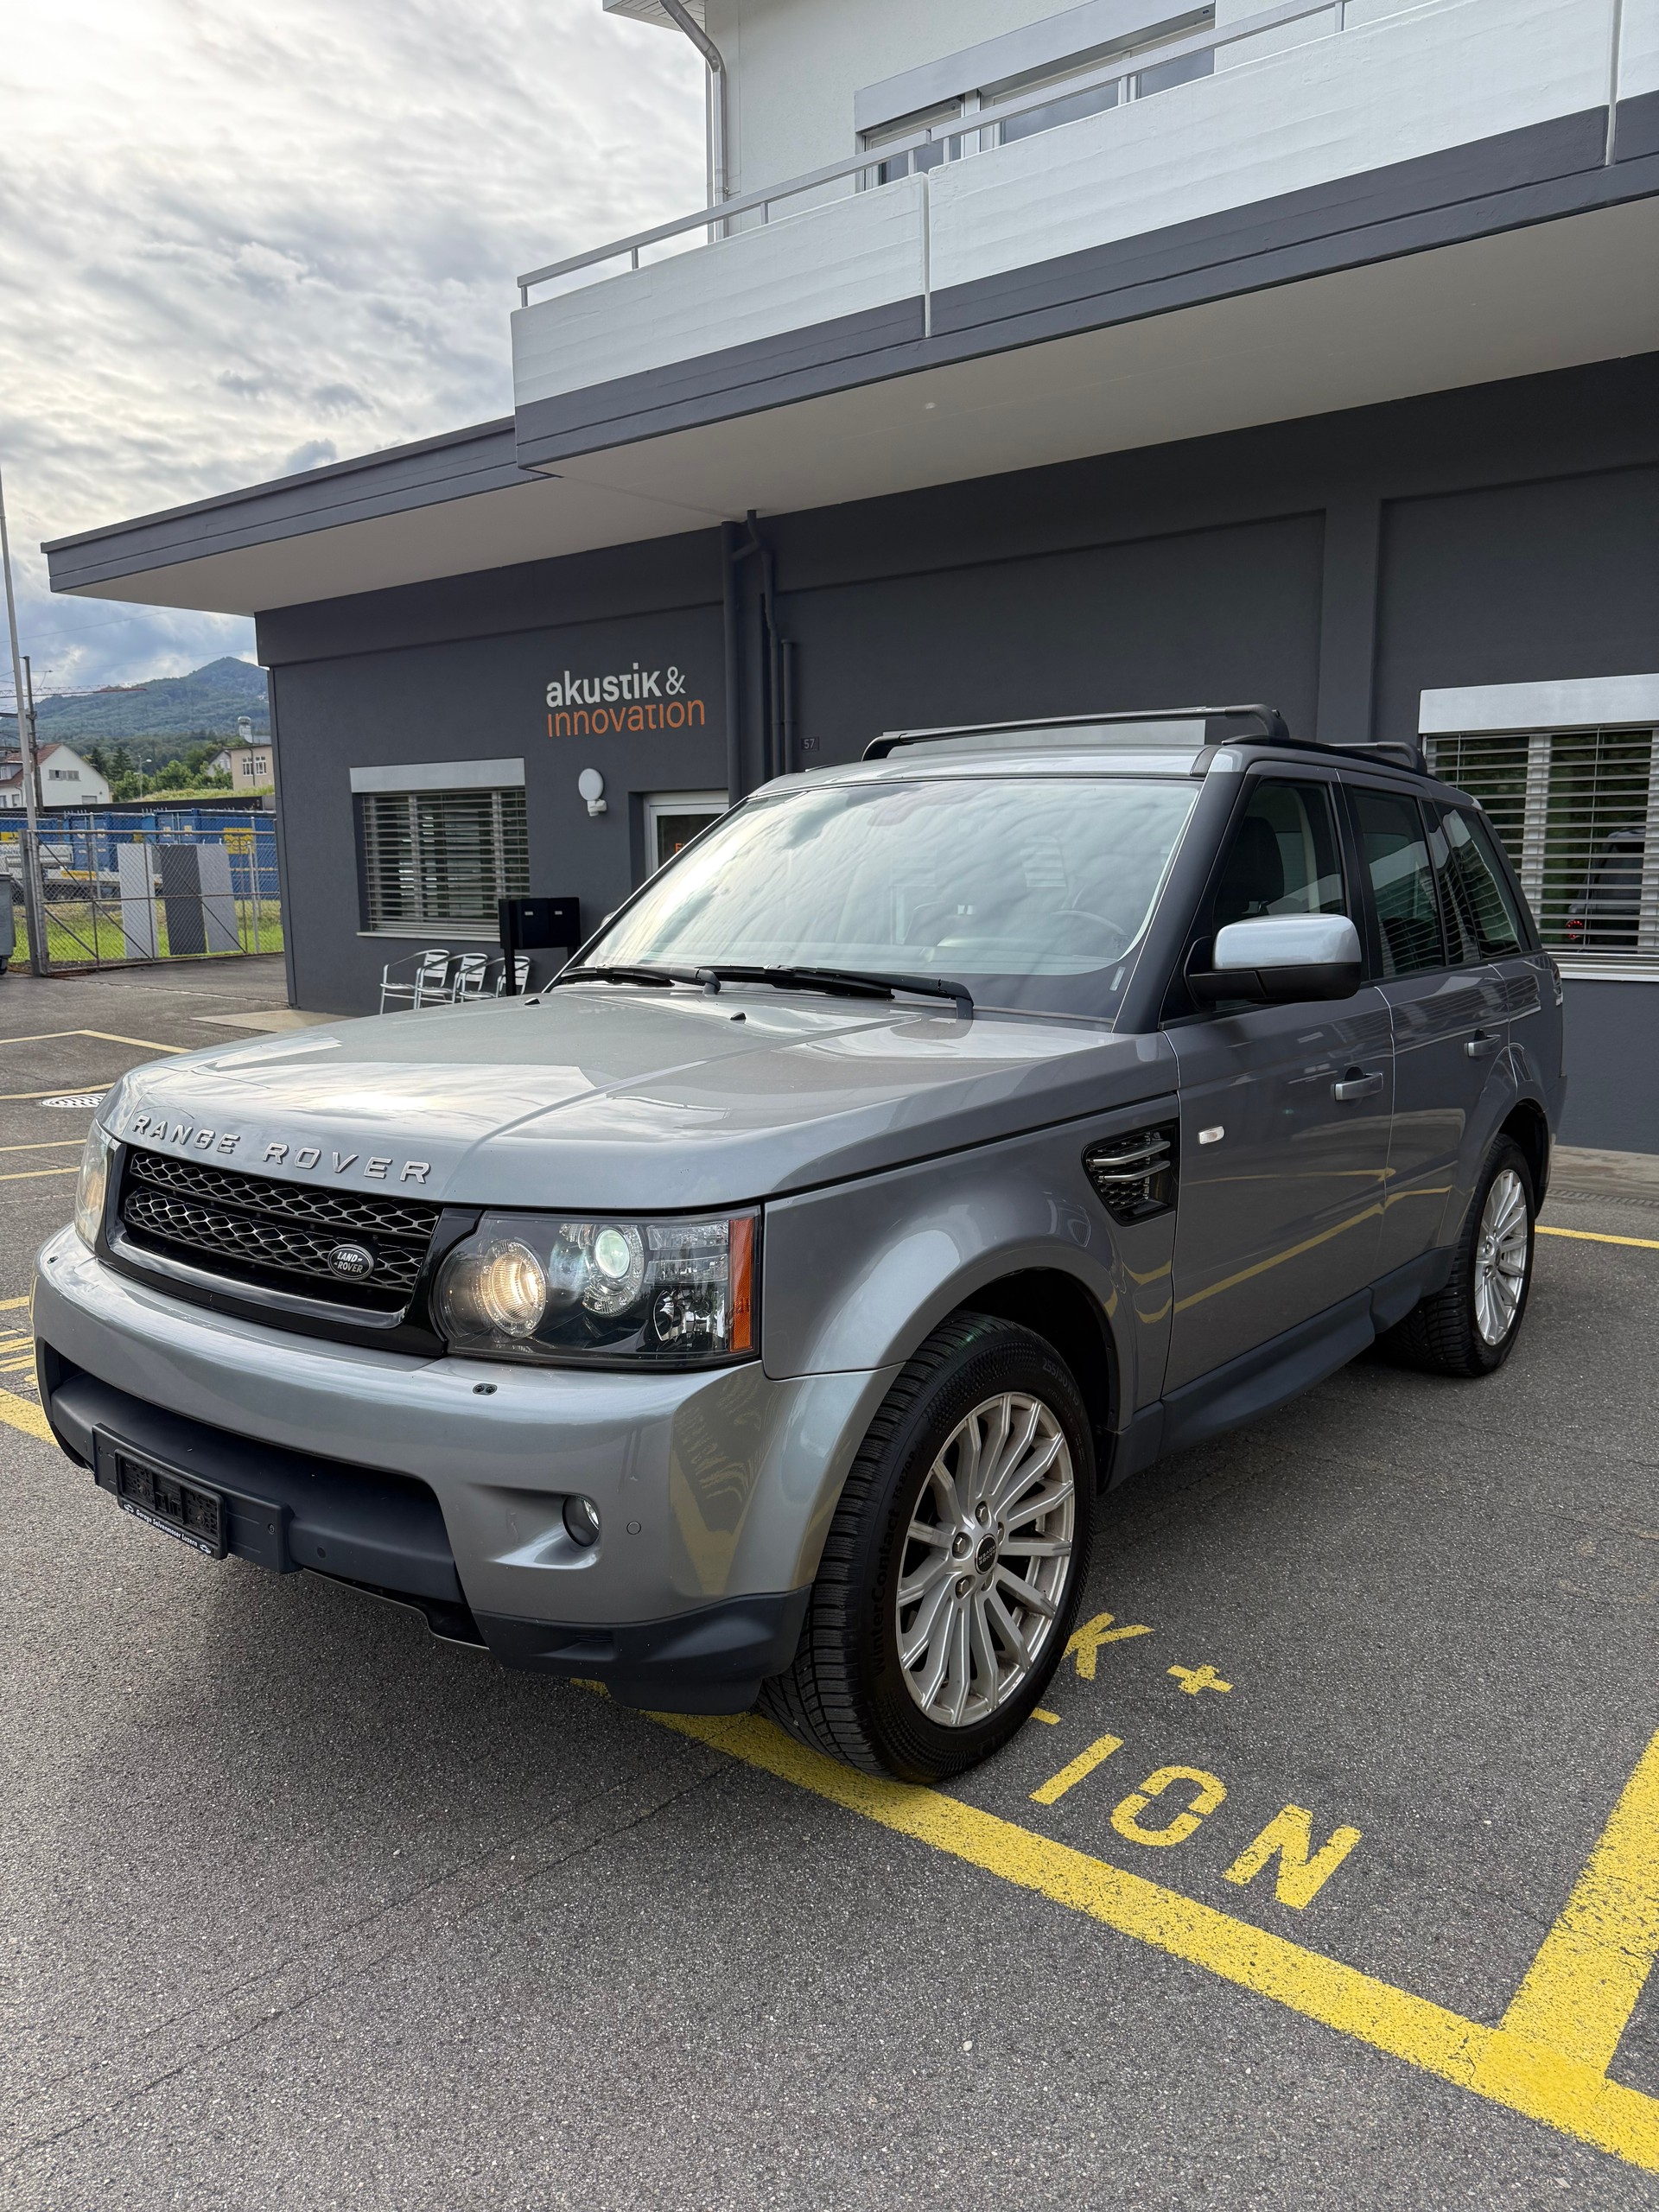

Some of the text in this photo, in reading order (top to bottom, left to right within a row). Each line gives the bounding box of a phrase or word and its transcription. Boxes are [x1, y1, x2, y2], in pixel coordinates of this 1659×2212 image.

[546, 663, 686, 708] akustik &
[548, 699, 705, 738] innovation
[804, 738, 815, 749] 57
[132, 1115, 431, 1184] RANGE ROVER
[337, 1251, 359, 1262] LAND
[337, 1261, 363, 1274] ROVER
